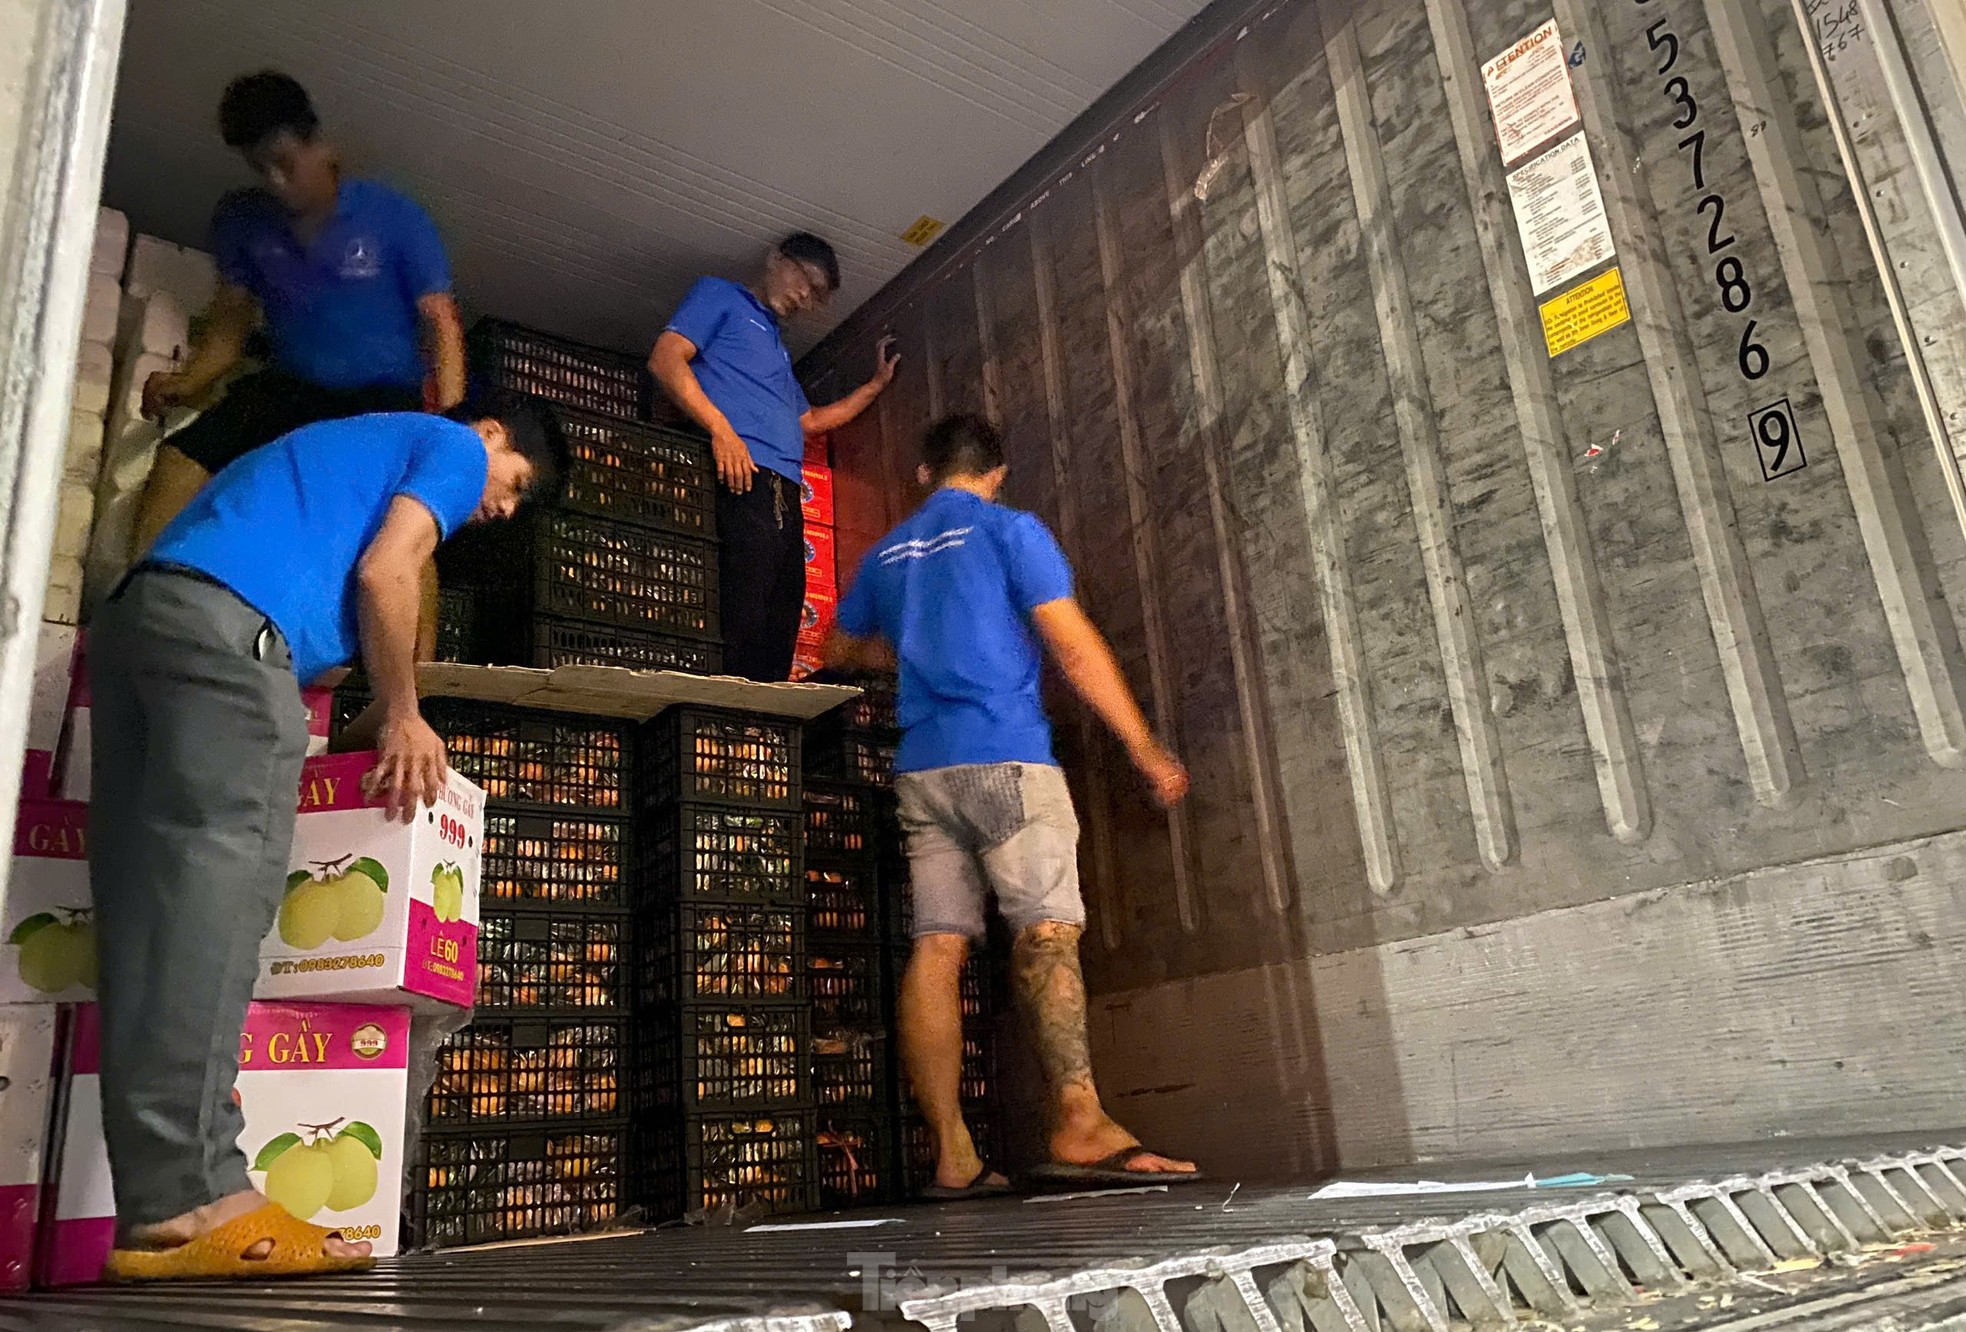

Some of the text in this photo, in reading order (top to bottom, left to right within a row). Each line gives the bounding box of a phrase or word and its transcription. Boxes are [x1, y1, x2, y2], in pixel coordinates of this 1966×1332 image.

[1512, 134, 1579, 181] SPECIFICATION DATA
[440, 813, 465, 850] 999
[360, 1038, 379, 1047] 999
